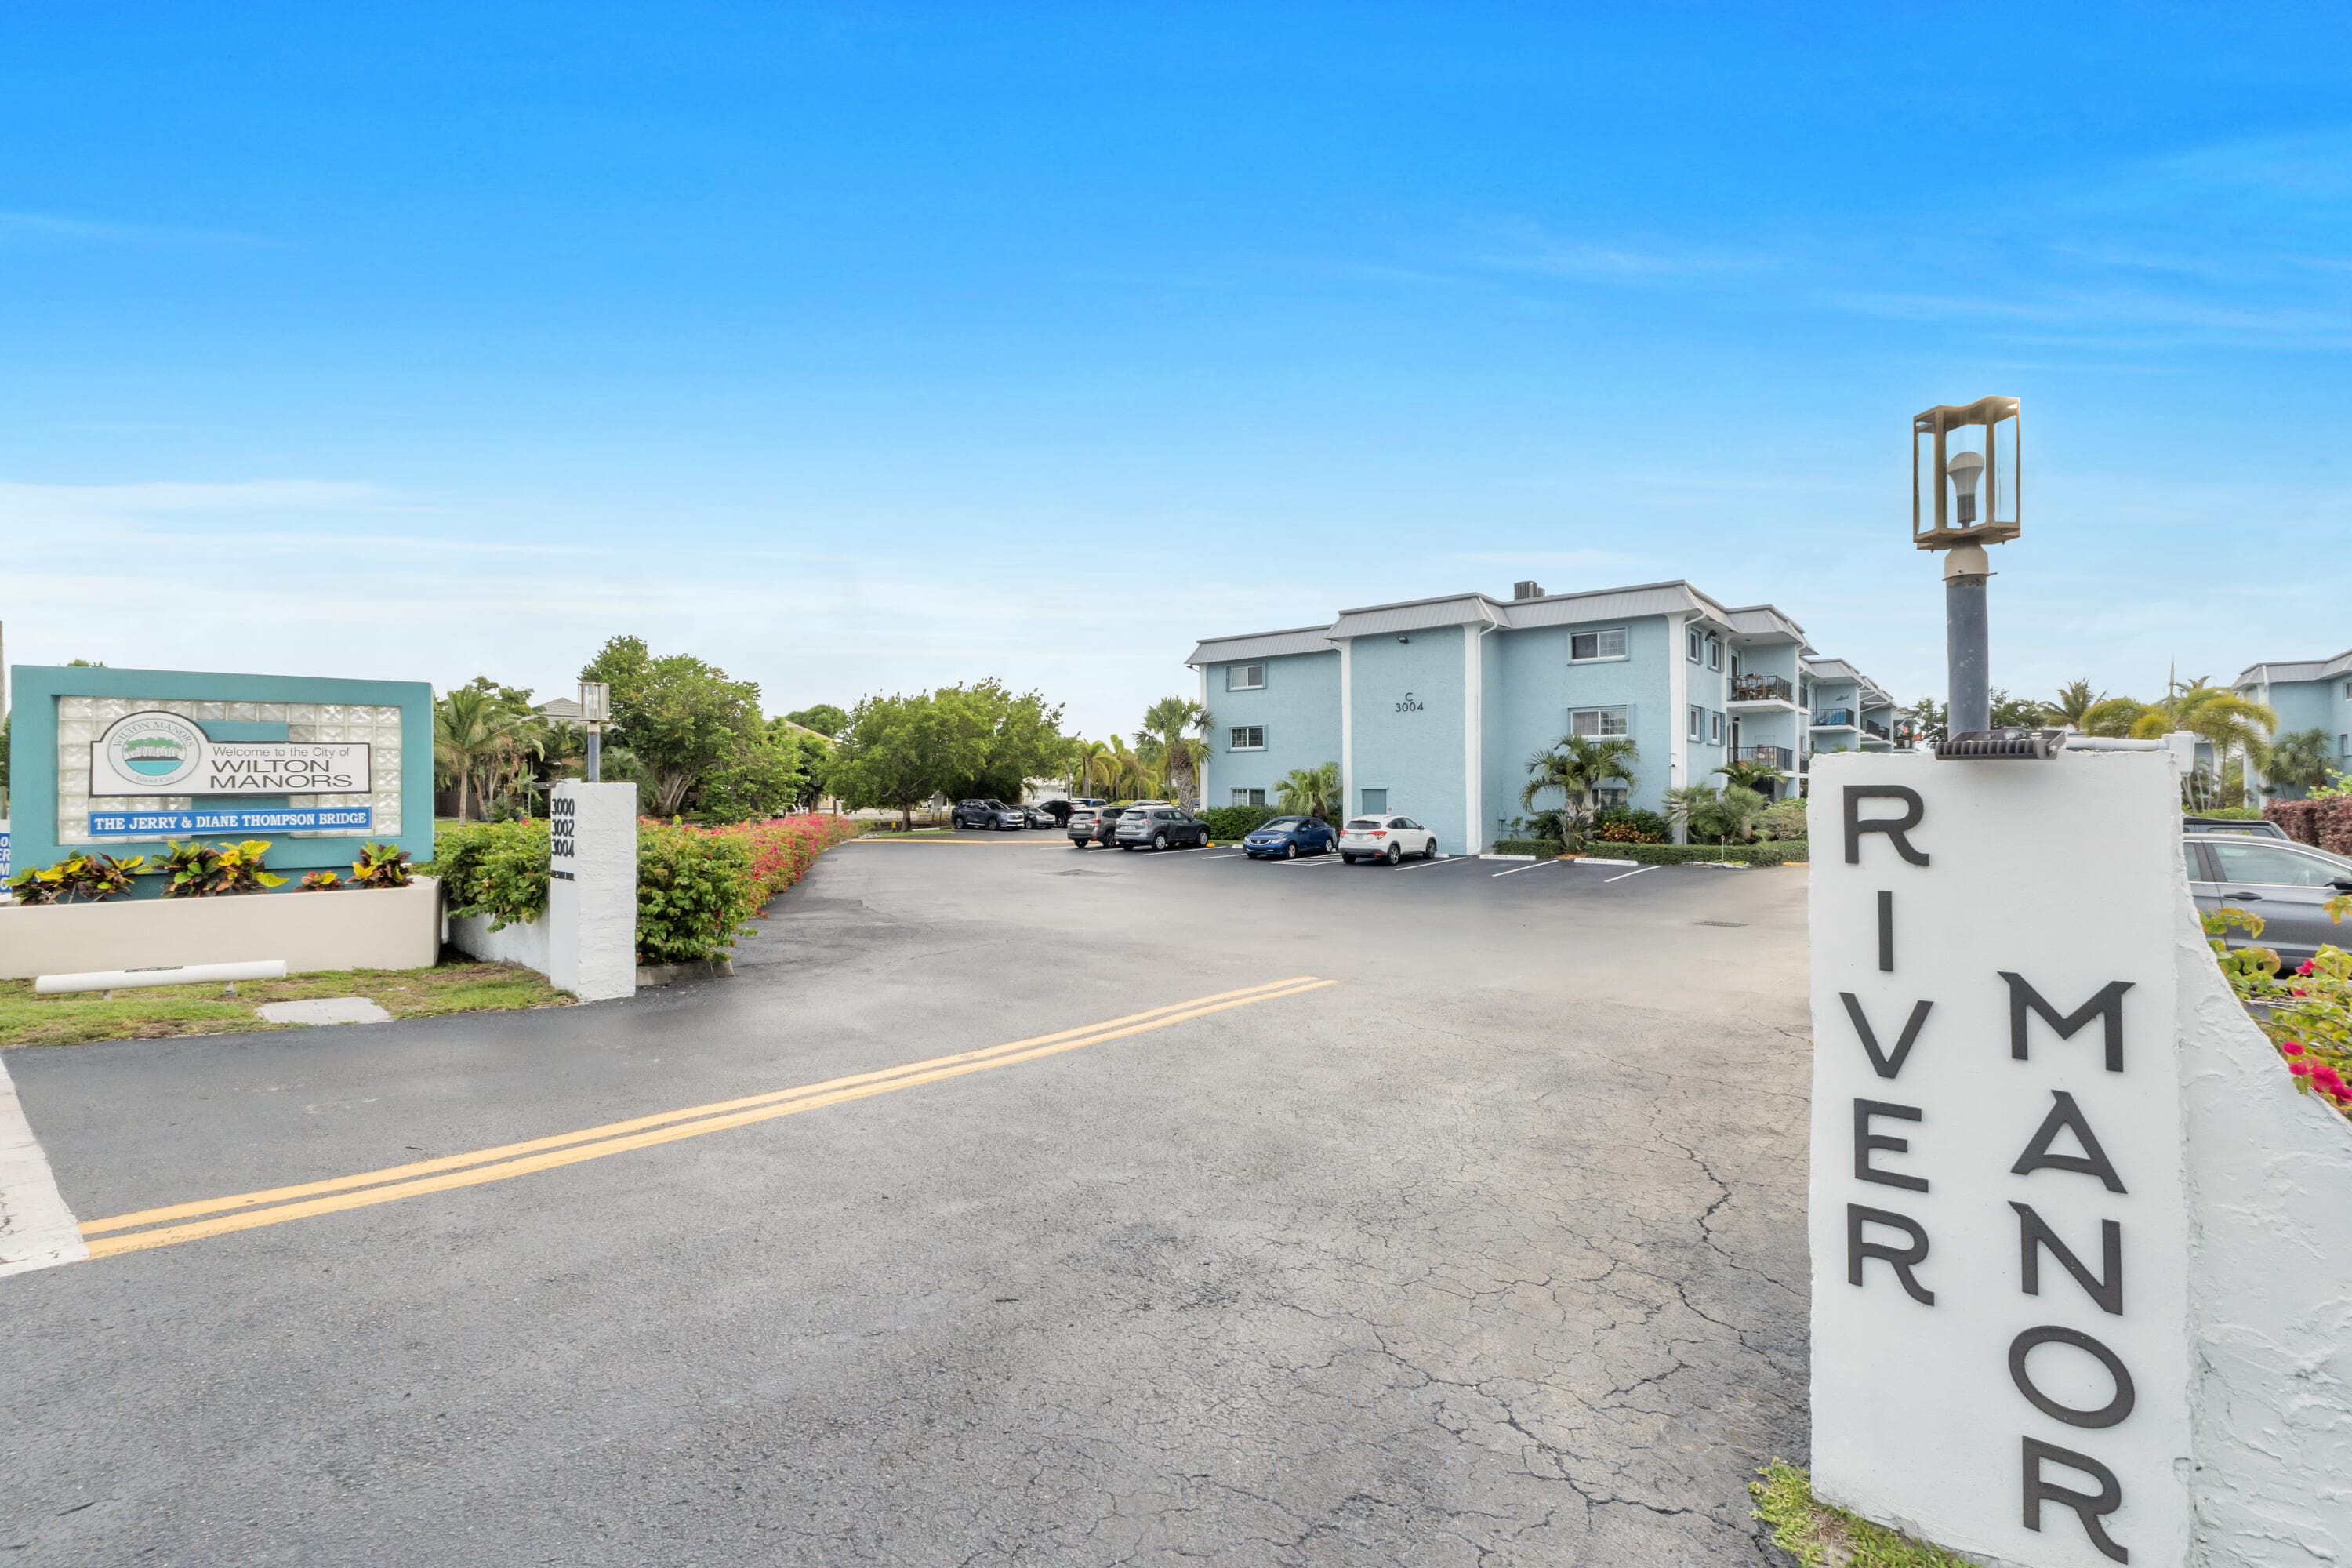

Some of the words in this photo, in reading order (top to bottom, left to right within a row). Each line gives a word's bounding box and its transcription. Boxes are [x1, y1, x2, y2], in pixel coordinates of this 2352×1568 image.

[1405, 691, 1414, 702] C
[1395, 702, 1424, 713] 3004
[112, 721, 150, 746] WILTON
[154, 721, 195, 747] MANORS
[213, 746, 270, 757] Welcome
[275, 747, 285, 757] to
[290, 747, 308, 757] the
[313, 747, 336, 759] City
[339, 747, 350, 757] of
[211, 760, 329, 773] WILTON
[210, 774, 353, 789] MANORS
[551, 798, 575, 816] 3000
[94, 818, 125, 830] THE
[129, 816, 178, 829] JERRY
[181, 816, 192, 829] &
[196, 815, 238, 829] DIANE
[241, 813, 315, 827] THOMPSON
[318, 812, 367, 825] BRIDGE
[551, 818, 575, 837] 3002
[551, 838, 575, 858] 3004
[1839, 784, 1934, 1307] RIVER
[1997, 971, 2136, 1566] MANOR
